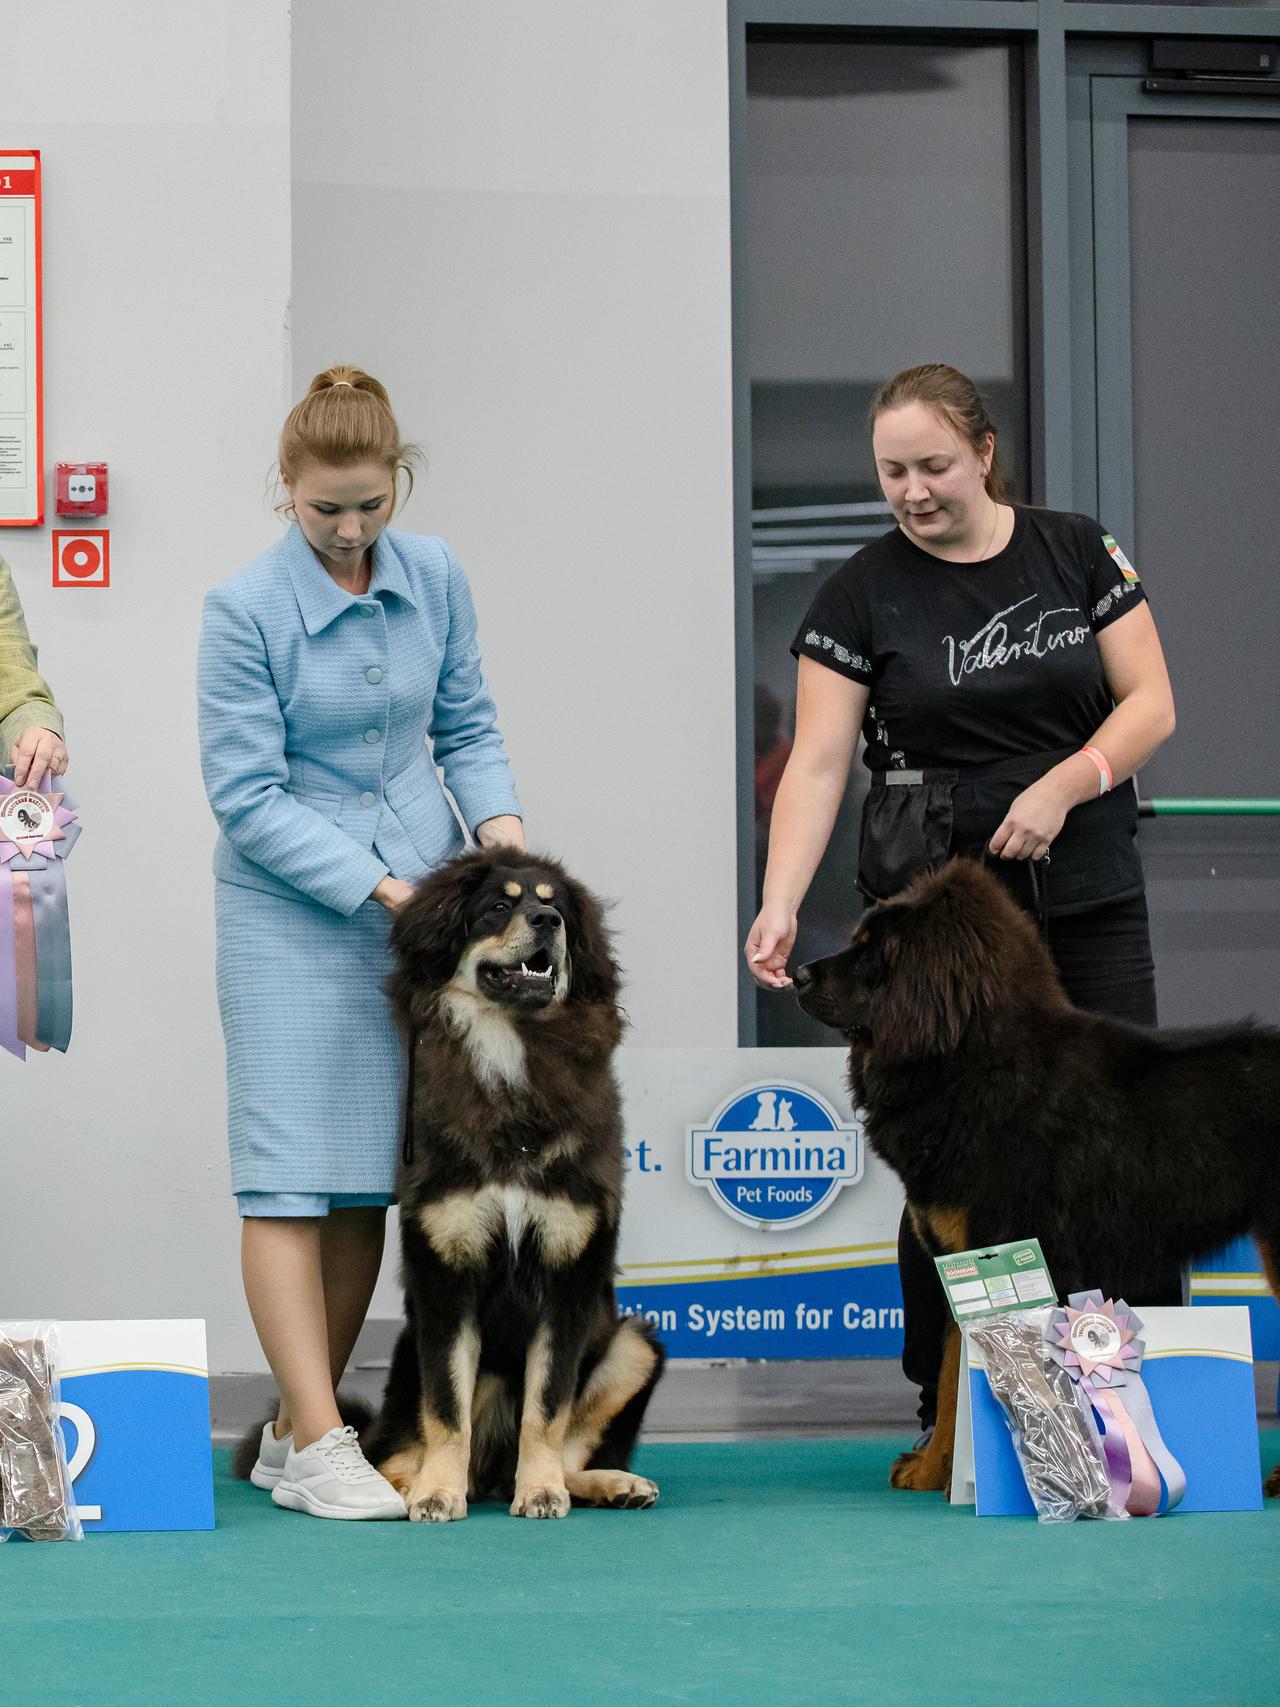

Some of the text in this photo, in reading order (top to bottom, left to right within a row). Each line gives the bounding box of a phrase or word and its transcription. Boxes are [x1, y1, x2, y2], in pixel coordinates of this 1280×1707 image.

[704, 1138, 846, 1172] Farmina
[737, 1186, 813, 1203] Pet Foods
[946, 1266, 977, 1277] ЗООМЕНЮ
[688, 1304, 786, 1337] System
[796, 1303, 833, 1331] for
[843, 1302, 904, 1329] Carn
